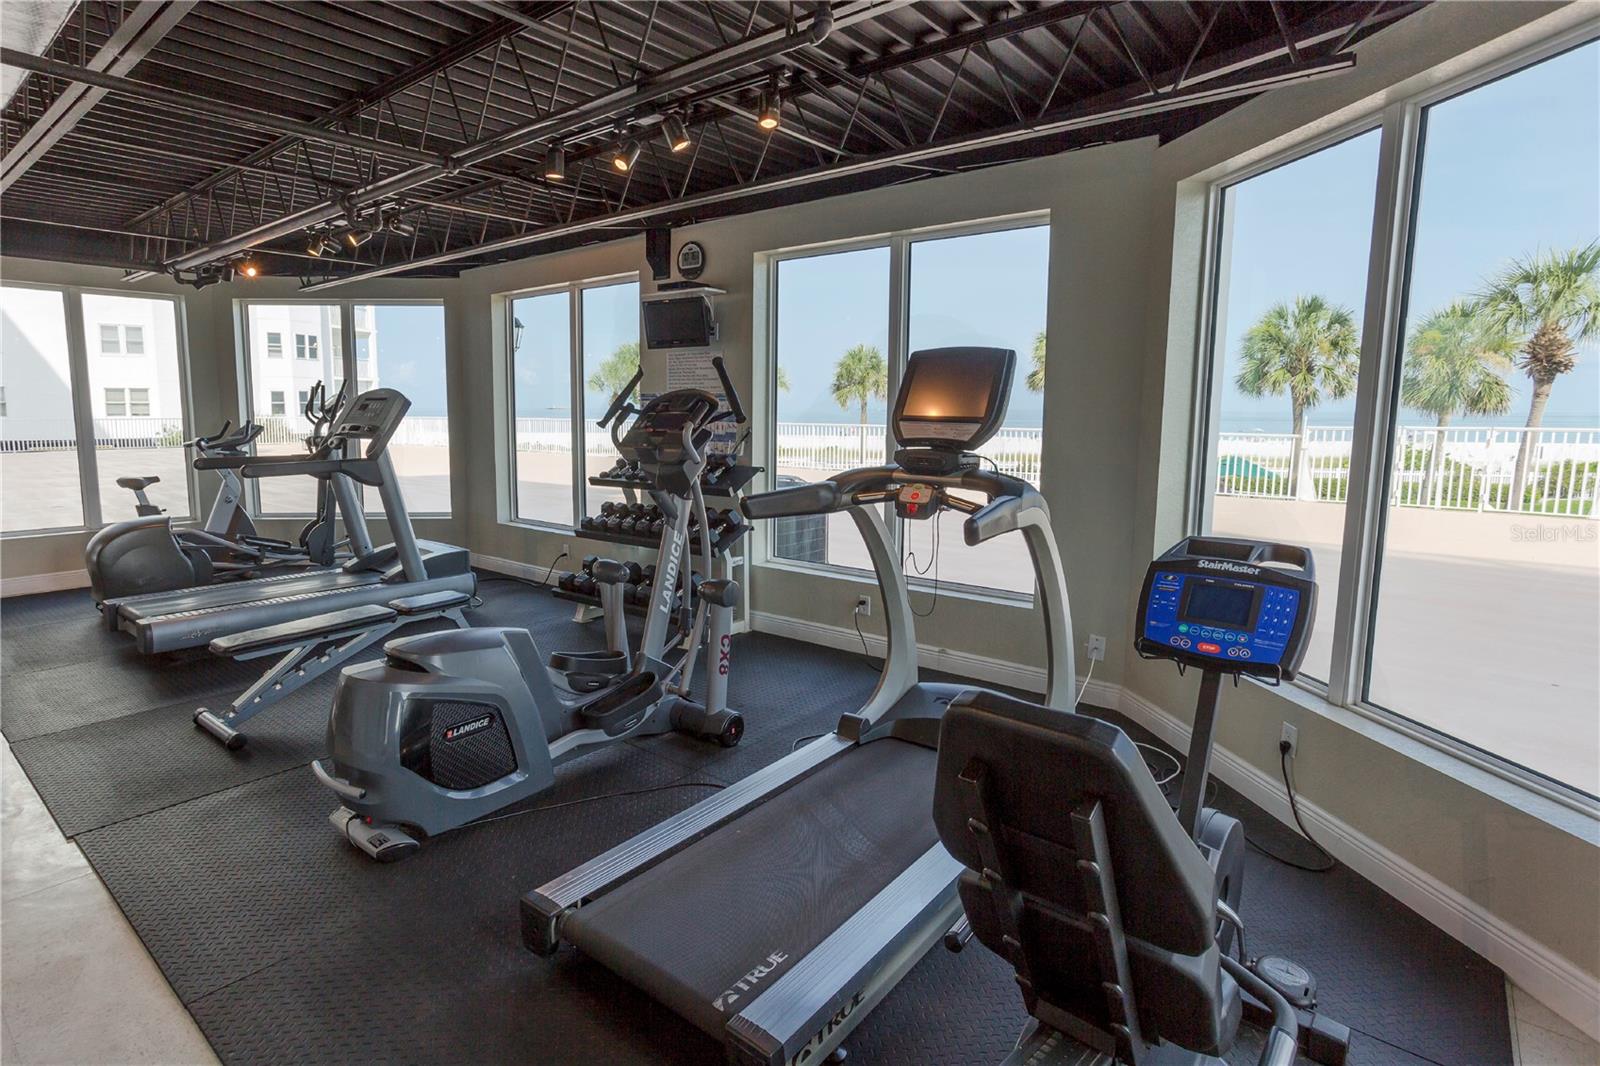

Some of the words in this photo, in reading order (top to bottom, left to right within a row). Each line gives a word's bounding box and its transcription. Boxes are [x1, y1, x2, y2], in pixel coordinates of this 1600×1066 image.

[660, 530, 683, 614] LANDICE
[1198, 559, 1261, 576] StairMaster
[719, 634, 732, 676] CX8
[453, 718, 490, 736] LANDICE
[732, 950, 789, 992] TRUE
